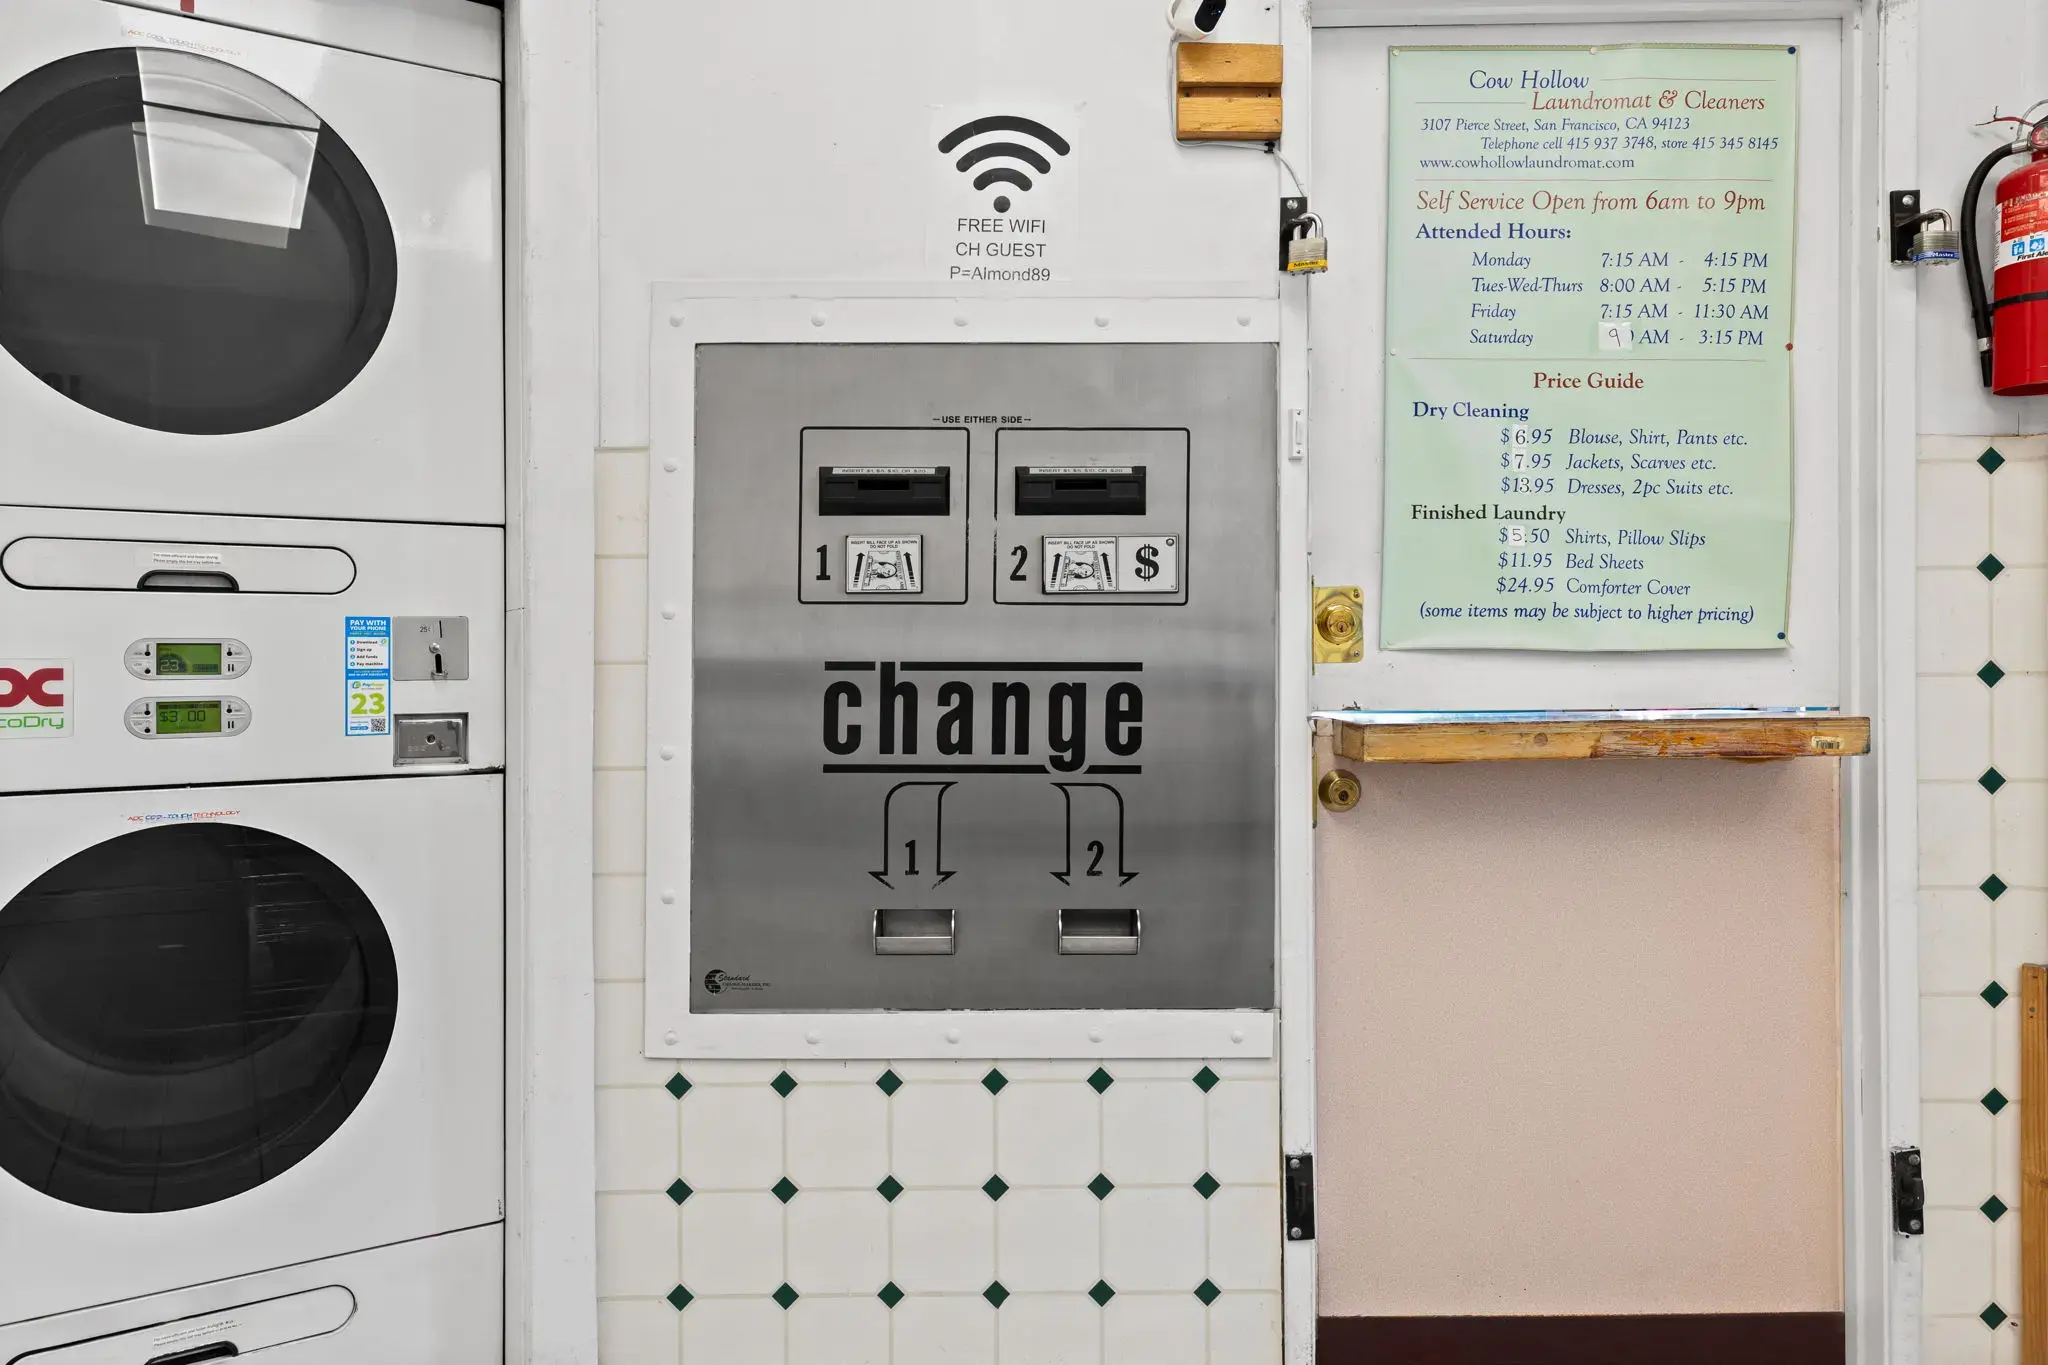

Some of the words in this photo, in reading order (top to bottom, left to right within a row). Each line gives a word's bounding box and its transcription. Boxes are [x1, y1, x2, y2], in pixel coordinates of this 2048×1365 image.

[1470, 70, 1513, 88] Cow
[1521, 69, 1589, 89] Hollow
[1532, 90, 1652, 111] Laundromat
[1659, 90, 1678, 109] &
[1685, 90, 1765, 110] Cleaners
[1421, 119, 1451, 131] 3107
[1456, 118, 1489, 130] Pierce
[1494, 118, 1529, 132] Street,
[1534, 119, 1557, 130] San
[1561, 118, 1619, 132] Francisco,
[1625, 117, 1648, 129] CA
[1652, 117, 1689, 130] 94123
[1481, 137, 1539, 152] Telephone
[1543, 136, 1564, 149] cell
[1567, 137, 1590, 150] 415
[1594, 136, 1618, 150] 937
[1623, 136, 1656, 150] 3748,
[1661, 139, 1688, 148] store
[1692, 137, 1715, 149] 415
[1720, 137, 1744, 150] 345
[1748, 137, 1778, 150] 8145
[1420, 154, 1634, 168] www.cowhollowlaundromat.com
[1417, 190, 1455, 214] Self
[1458, 190, 1524, 210] Service
[1533, 190, 1586, 214] Open
[1592, 191, 1638, 214] from
[1646, 190, 1689, 209] 6am
[1698, 196, 1715, 209] to
[1724, 191, 1765, 214] 9pm
[958, 218, 1003, 232] FREE
[1009, 219, 1045, 233] WIFI
[1416, 222, 1501, 239] Attended
[1508, 223, 1571, 239] Hours:
[956, 242, 980, 256] CH
[986, 243, 1046, 257] GUEST
[2017, 252, 2034, 260] First
[1472, 251, 1531, 269] Monday
[1602, 252, 1634, 268] 7:15
[1638, 252, 1668, 266] AM
[1704, 252, 1738, 267] 4:15
[1743, 253, 1768, 267] PM
[950, 266, 1050, 281] P=Almond89
[1472, 277, 1583, 292] Tues-Wed-Thurs
[1600, 278, 1635, 292] 8:00
[1639, 278, 1670, 292] AM
[1702, 278, 1736, 292] 5:15
[1741, 278, 1766, 293] PM
[1471, 303, 1516, 321] Friday
[1601, 304, 1632, 319] 7:15
[1637, 304, 1667, 318] AM
[1695, 304, 1735, 318] 11:30
[1740, 305, 1768, 319] AM
[1470, 329, 1533, 346] Saturday
[1639, 329, 1668, 344] AM
[1699, 330, 1733, 344] 3:15
[1738, 330, 1762, 345] PM
[1534, 372, 1581, 388] Price
[1587, 372, 1644, 388] Guide
[1001, 416, 1022, 424] SIDE
[1413, 401, 1448, 420] Dry
[1453, 402, 1529, 422] Cleaning
[1568, 428, 1622, 447] Blouse,
[1629, 429, 1669, 447] Shirt,
[1677, 429, 1717, 444] Pants
[1723, 434, 1747, 445] etc.
[1565, 453, 1623, 472] Jackets,
[1631, 453, 1685, 469] Scarves
[1691, 459, 1716, 470] etc.
[1568, 478, 1624, 496] Dresses,
[1632, 479, 1660, 497] 2pc
[1666, 479, 1703, 494] Suits
[1709, 484, 1733, 494] etc.
[1411, 504, 1487, 519] Finished
[1493, 504, 1565, 524] Laundry
[1565, 528, 1611, 547] Shirts,
[1618, 529, 1664, 545] Pillow
[1669, 530, 1705, 549] Slips
[816, 545, 831, 580] 1
[1010, 545, 1028, 581] 2
[1135, 544, 1159, 582] $
[1498, 551, 1552, 569] $11.95
[1566, 553, 1594, 568] Bed
[1599, 553, 1643, 569] Sheets
[1496, 576, 1554, 594] $24.95
[1567, 578, 1642, 597] Comforter
[1647, 579, 1690, 595] Cover
[1420, 601, 1462, 619] (some
[1468, 604, 1508, 617] items
[1514, 607, 1546, 621] may
[1553, 602, 1569, 617] be
[1574, 603, 1622, 622] subject
[1628, 608, 1641, 619] to
[1648, 604, 1693, 623] higher
[1697, 605, 1753, 624] pricing)
[351, 693, 385, 714] 23
[823, 661, 1143, 772] change
[194, 810, 240, 819] TECHNOLOGY
[905, 840, 919, 876] 1
[1087, 840, 1104, 876] 2
